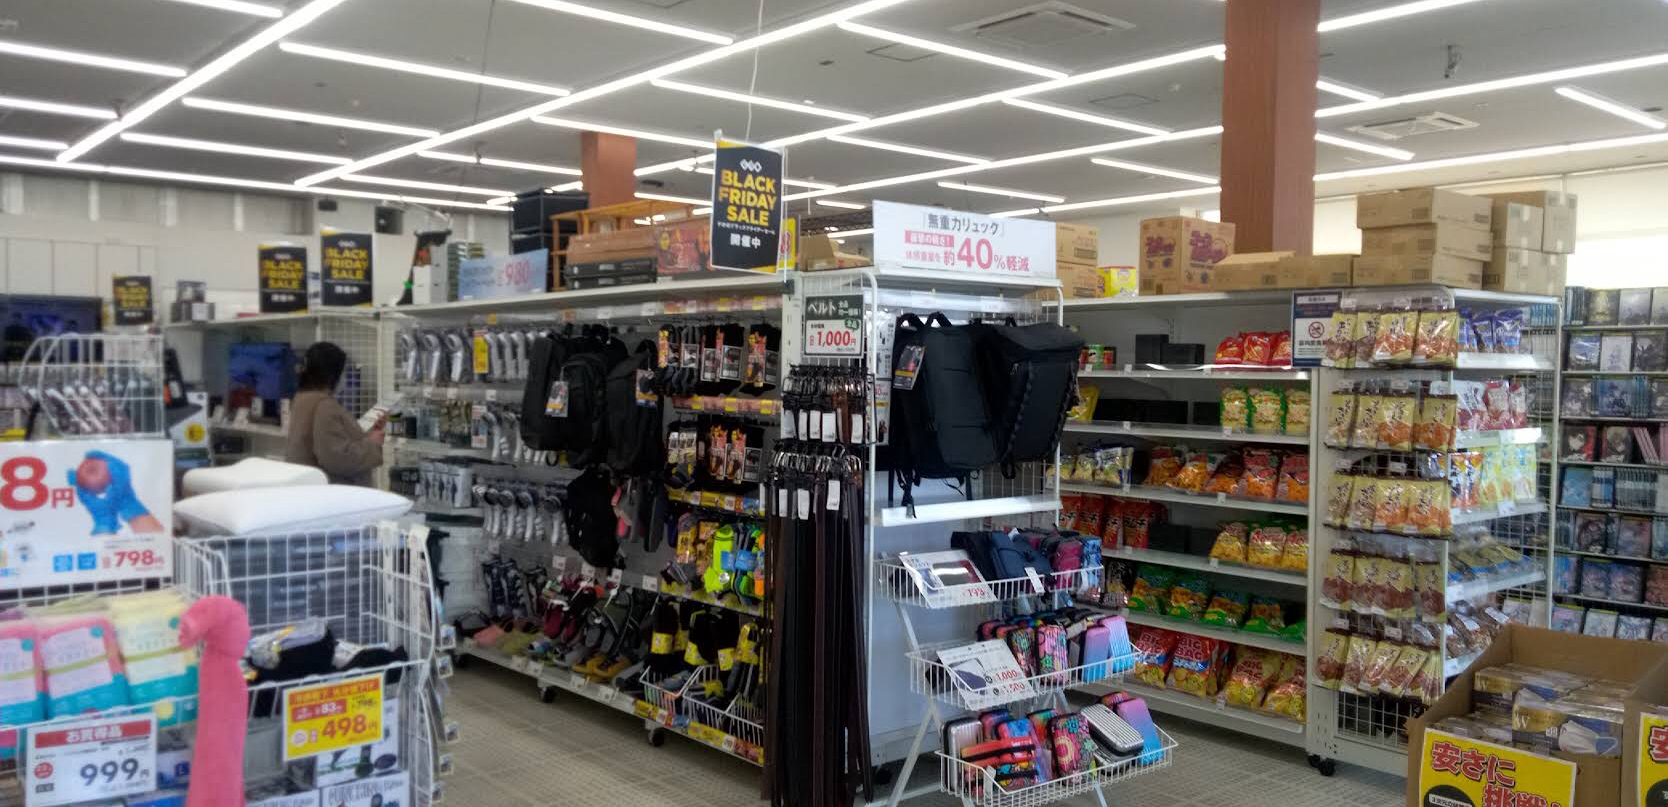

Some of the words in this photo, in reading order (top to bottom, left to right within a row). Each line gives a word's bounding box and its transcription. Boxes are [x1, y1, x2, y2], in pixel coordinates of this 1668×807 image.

[721, 169, 776, 193] BLACK
[718, 186, 777, 211] FRIDAY
[726, 206, 769, 226] SALE
[807, 301, 836, 316] ベルト
[817, 330, 856, 347] 1,000円
[1139, 631, 1162, 646] BIG
[1178, 636, 1202, 650] BIG
[1175, 646, 1202, 660] BAG
[1431, 740, 1516, 788] 安さに
